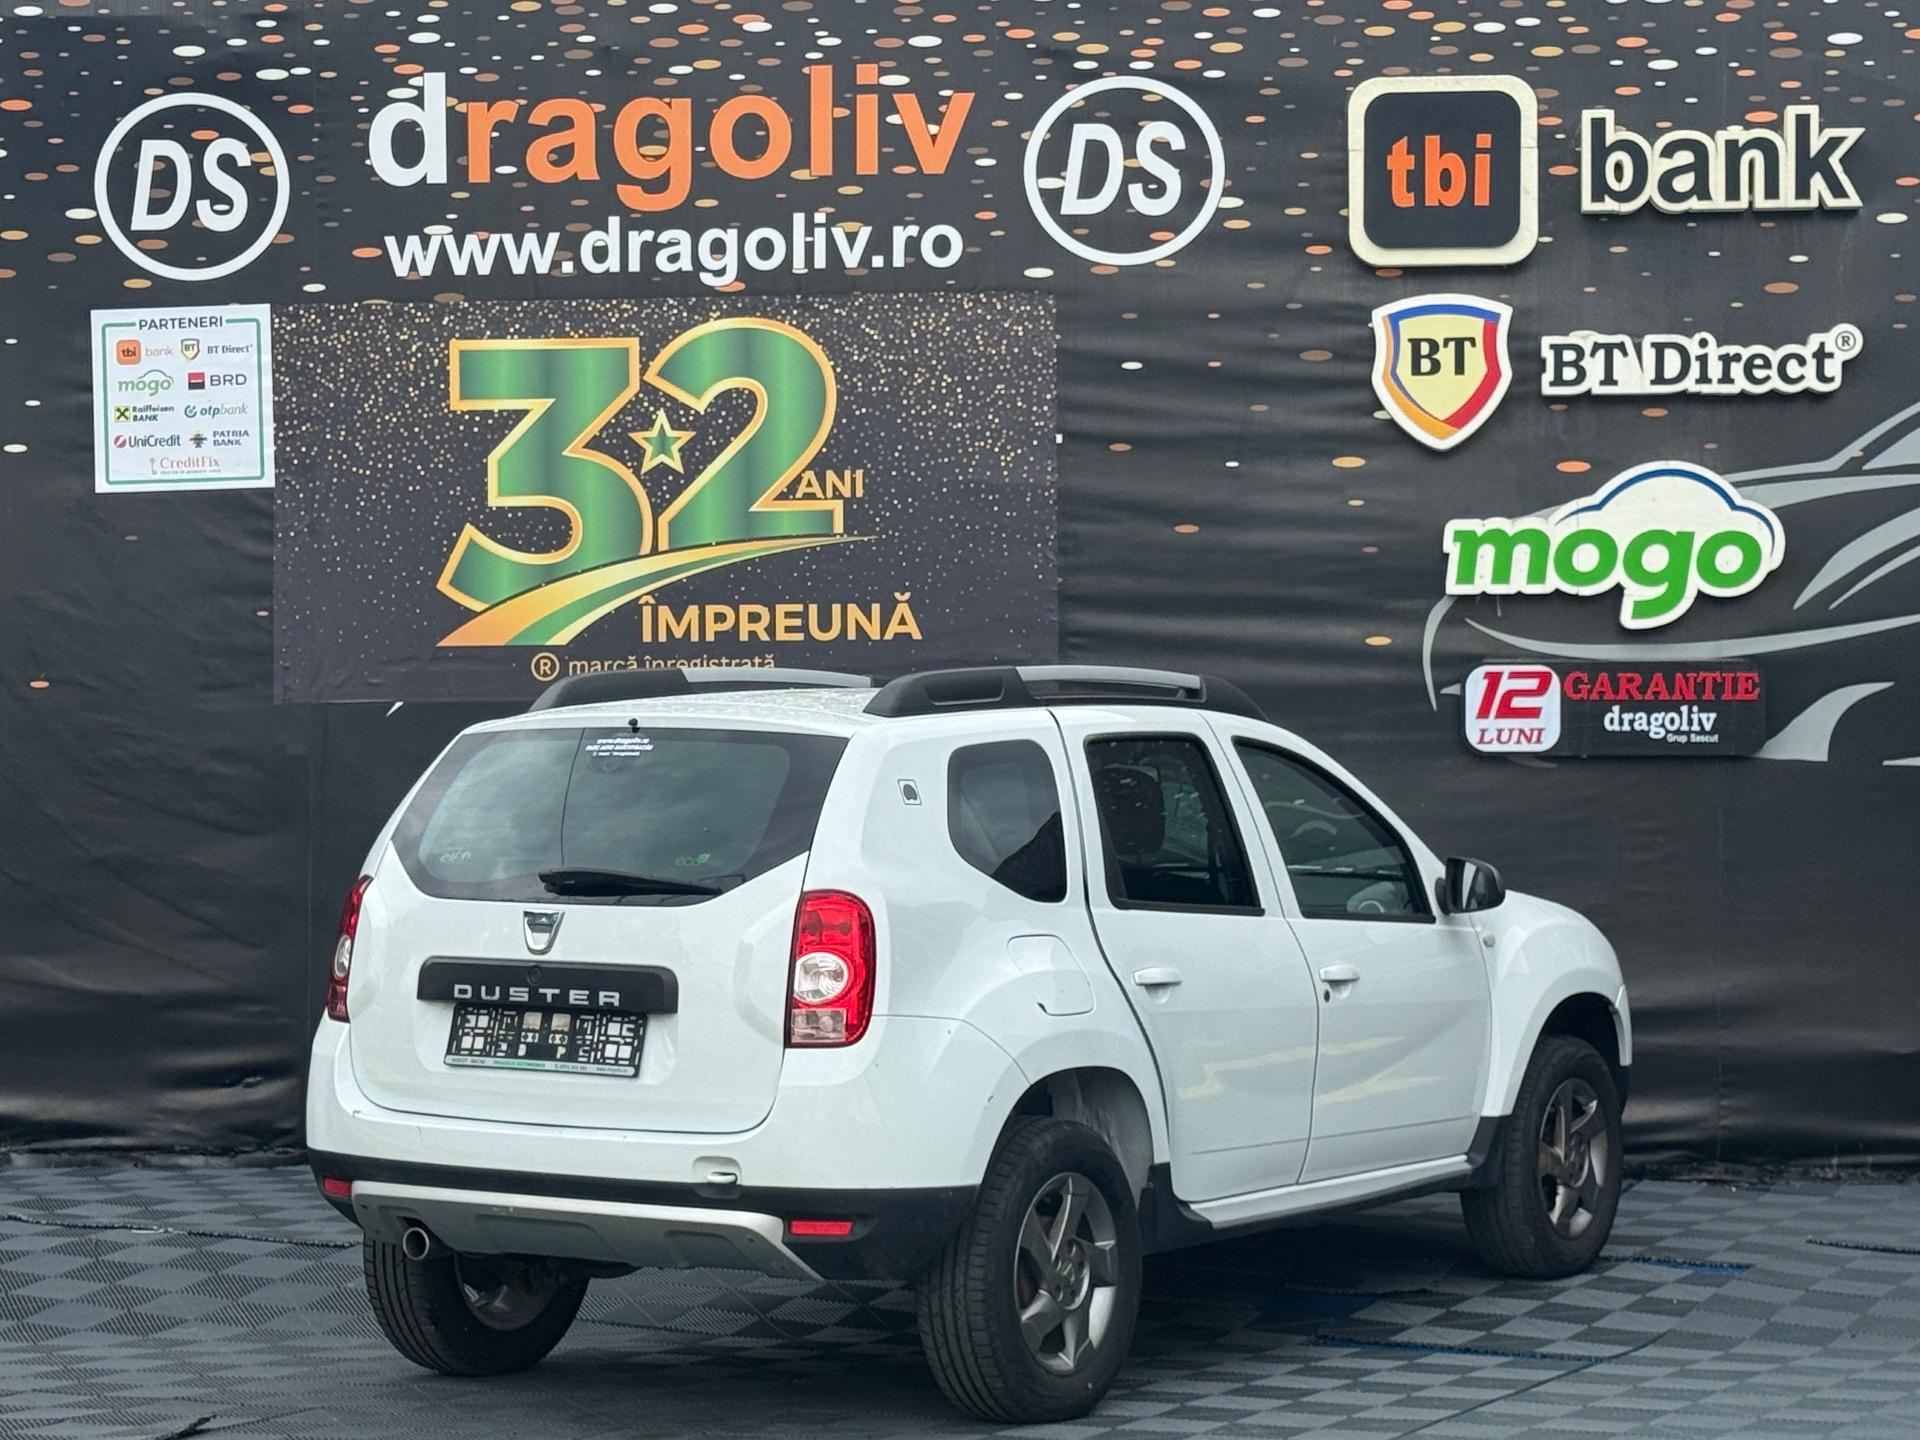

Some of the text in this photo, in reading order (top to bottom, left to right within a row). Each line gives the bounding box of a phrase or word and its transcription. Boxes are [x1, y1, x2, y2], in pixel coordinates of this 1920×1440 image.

[368, 62, 976, 212] dragoliv
[1059, 120, 1187, 217] DS
[1386, 108, 1860, 209] tbi bank
[130, 137, 252, 233] DS
[383, 211, 964, 287] www.dragoliv.ro
[138, 315, 223, 331] PARTENERI
[121, 346, 175, 358] tbi bank
[207, 345, 220, 355] BT
[1407, 336, 1477, 377] BT
[1549, 341, 1630, 387] BT
[117, 378, 172, 397] mogo
[209, 374, 247, 386] BRD
[132, 414, 159, 423] BANK
[128, 434, 182, 448] UniCredit
[213, 430, 250, 438] PATRIA
[213, 438, 242, 447] BANK
[436, 317, 844, 613] 32
[795, 469, 864, 498] ANI
[1453, 528, 1762, 620] mogo
[638, 592, 923, 643] ÎMPREUNĂ
[1476, 671, 1553, 720] 12
[1564, 671, 1760, 701] GARANTIE
[1476, 728, 1546, 745] LUNI
[1603, 705, 1717, 739] dragoliv
[453, 983, 620, 1007] DUSTER
